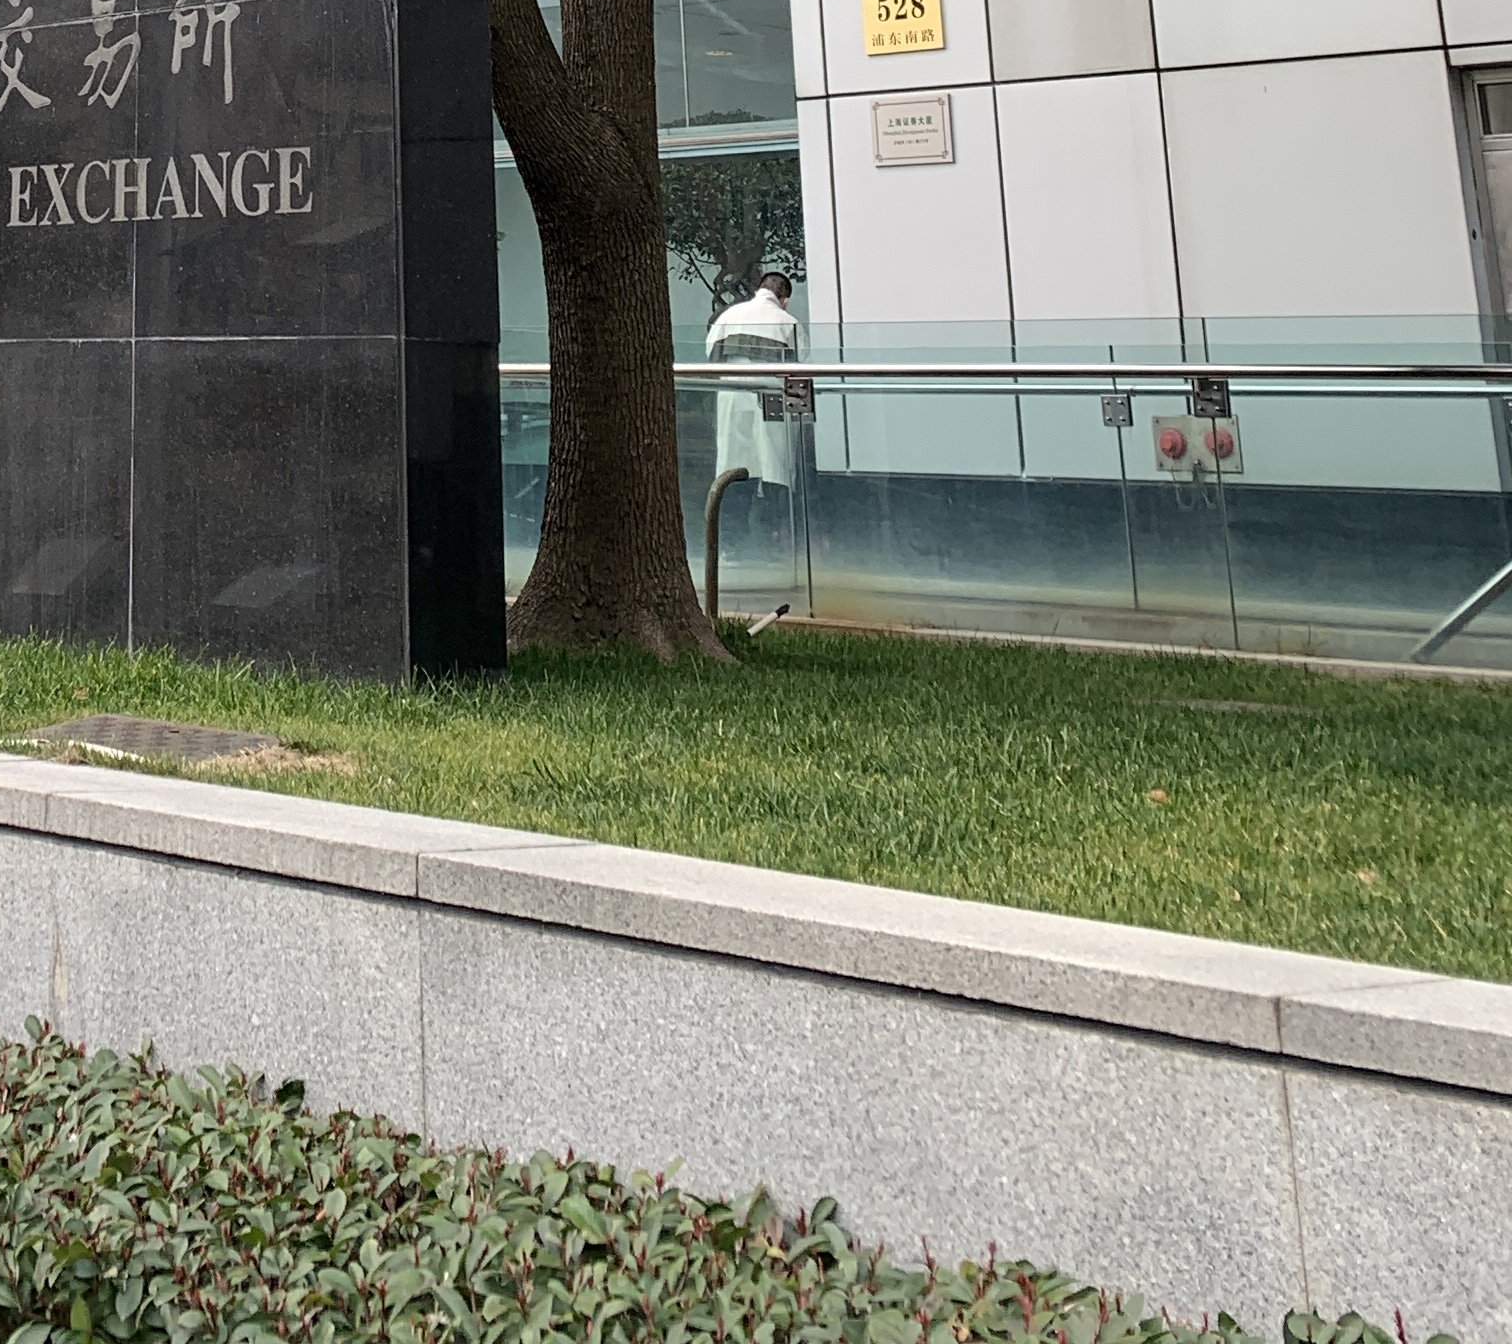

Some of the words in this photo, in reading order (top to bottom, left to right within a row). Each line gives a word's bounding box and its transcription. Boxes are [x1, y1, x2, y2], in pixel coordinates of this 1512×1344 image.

[871, 28, 935, 47] 浦东南路
[6, 146, 314, 228] EXCHANGE
